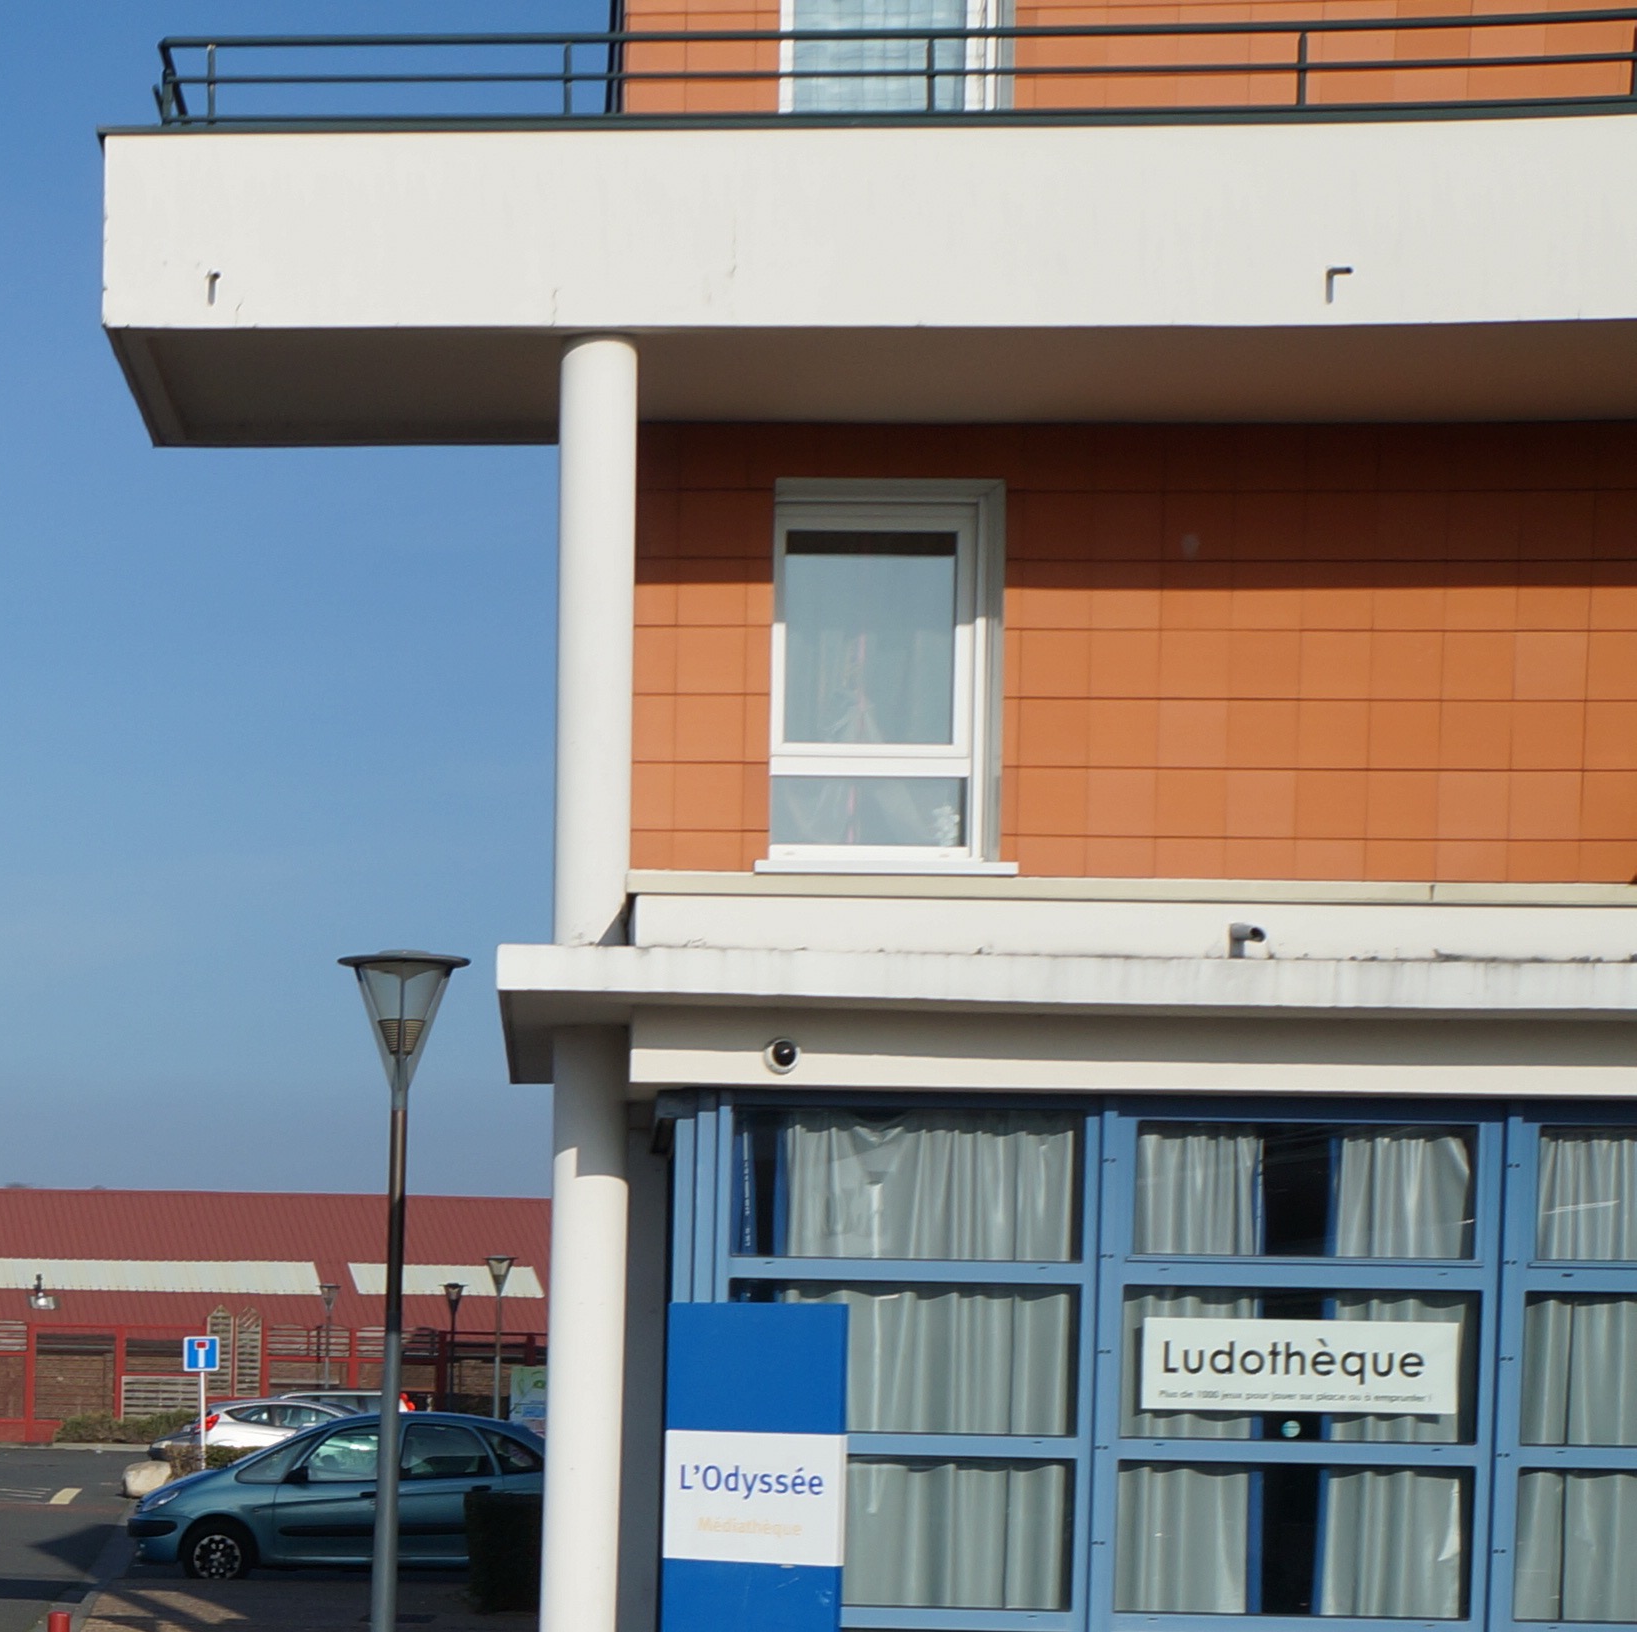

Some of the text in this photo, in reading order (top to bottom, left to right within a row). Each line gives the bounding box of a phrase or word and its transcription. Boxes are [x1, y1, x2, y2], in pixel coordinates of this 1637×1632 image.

[1162, 1338, 1425, 1385] Ludothèque
[679, 1463, 824, 1500] L'Odyssée
[697, 1516, 803, 1537] Médiathèque
